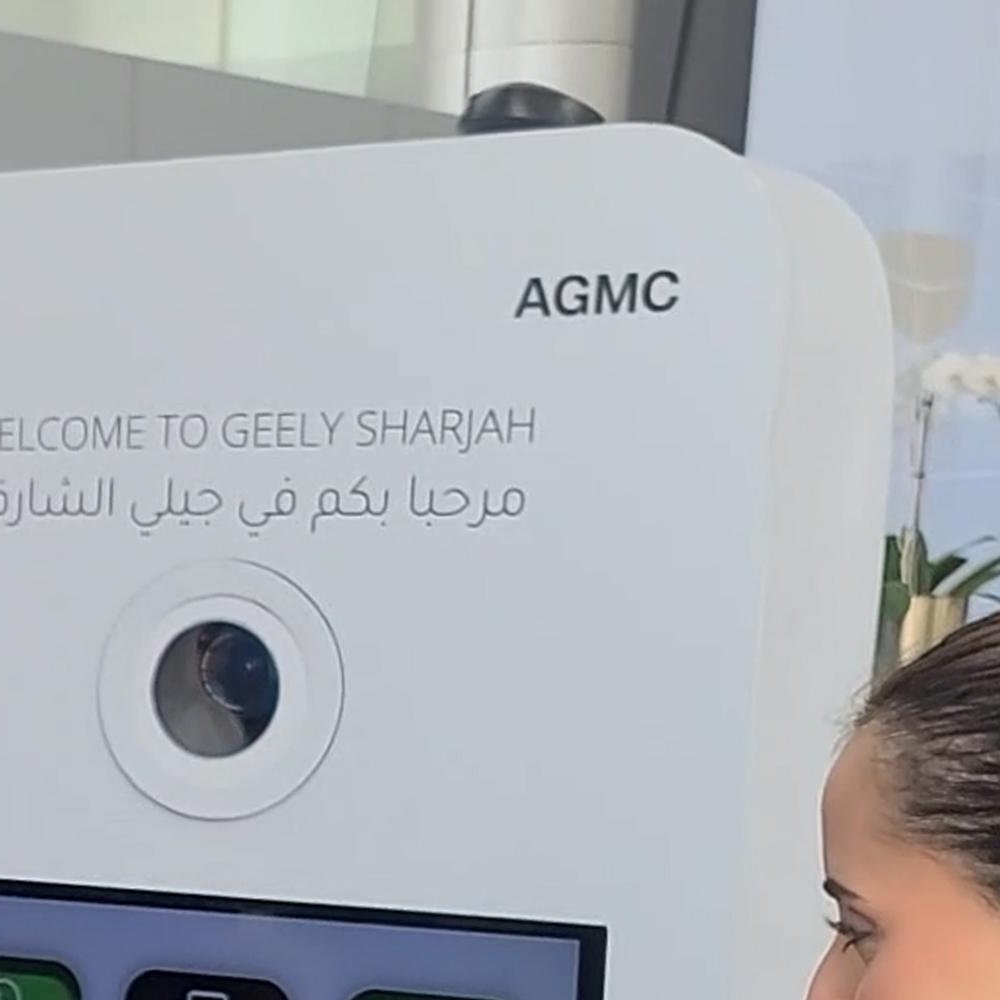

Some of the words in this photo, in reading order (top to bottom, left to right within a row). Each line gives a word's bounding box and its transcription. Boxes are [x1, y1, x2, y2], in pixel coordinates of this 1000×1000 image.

[514, 269, 680, 319] AGMC
[157, 413, 208, 449] TO
[221, 411, 344, 449] GEELY
[356, 406, 536, 454] SHARJAH
[131, 476, 224, 538] جيلي
[238, 475, 298, 538] في
[310, 474, 389, 534] بكم
[409, 474, 526, 528] مرحبا
